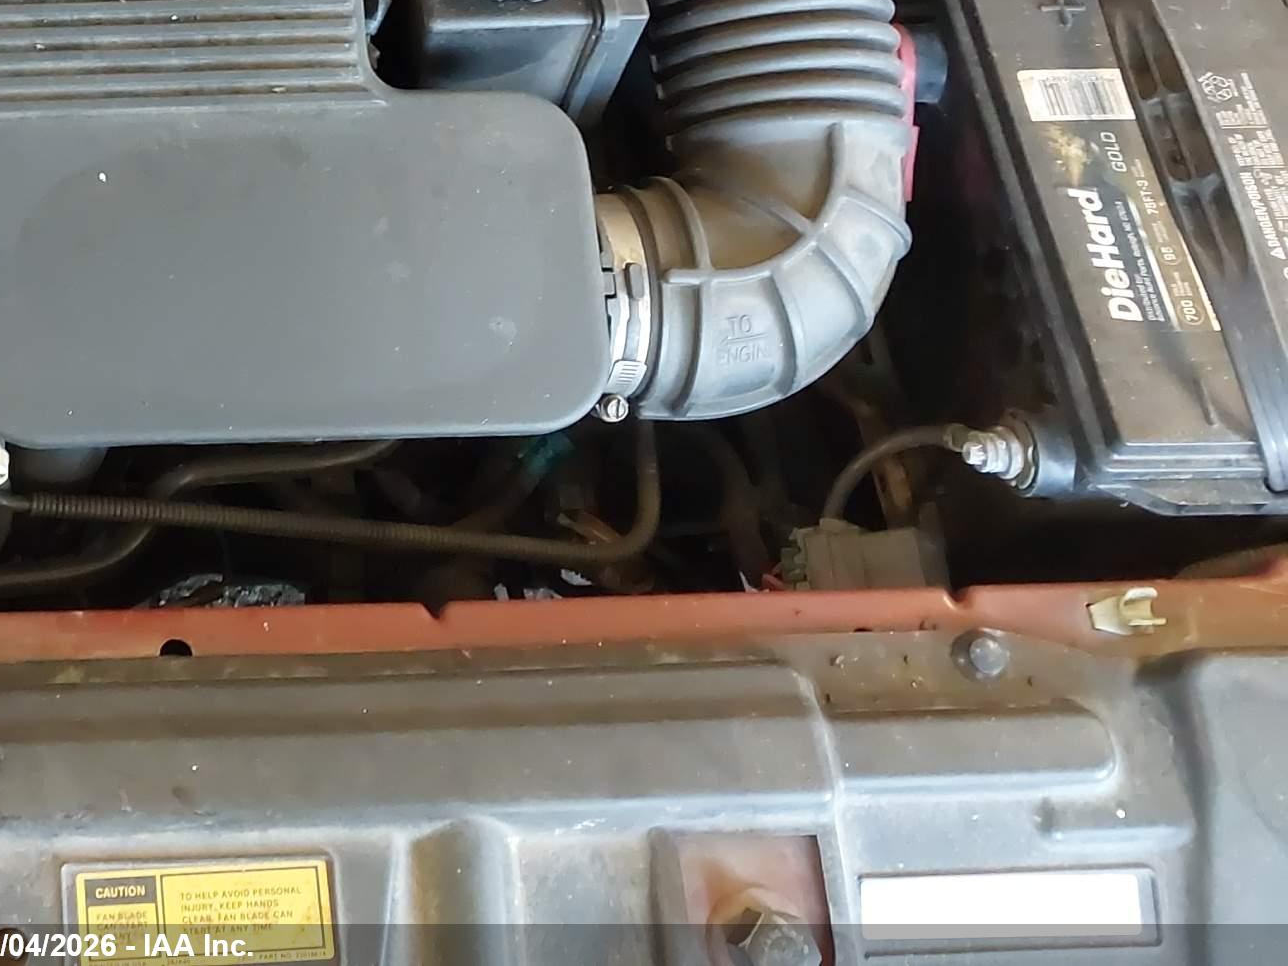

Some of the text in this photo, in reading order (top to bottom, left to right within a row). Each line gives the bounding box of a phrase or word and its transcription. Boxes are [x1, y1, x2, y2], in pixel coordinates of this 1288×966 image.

[1100, 131, 1127, 173] GOLD
[1068, 186, 1144, 322] DieHard
[726, 314, 753, 335] TO
[95, 885, 146, 899] CAUTION
[180, 886, 302, 901] TO HELP AVOID PERSONAL
[219, 900, 244, 910] KEEP
[245, 898, 279, 909] HANDS
[238, 911, 271, 922] BLADE
[272, 910, 294, 920] CAN
